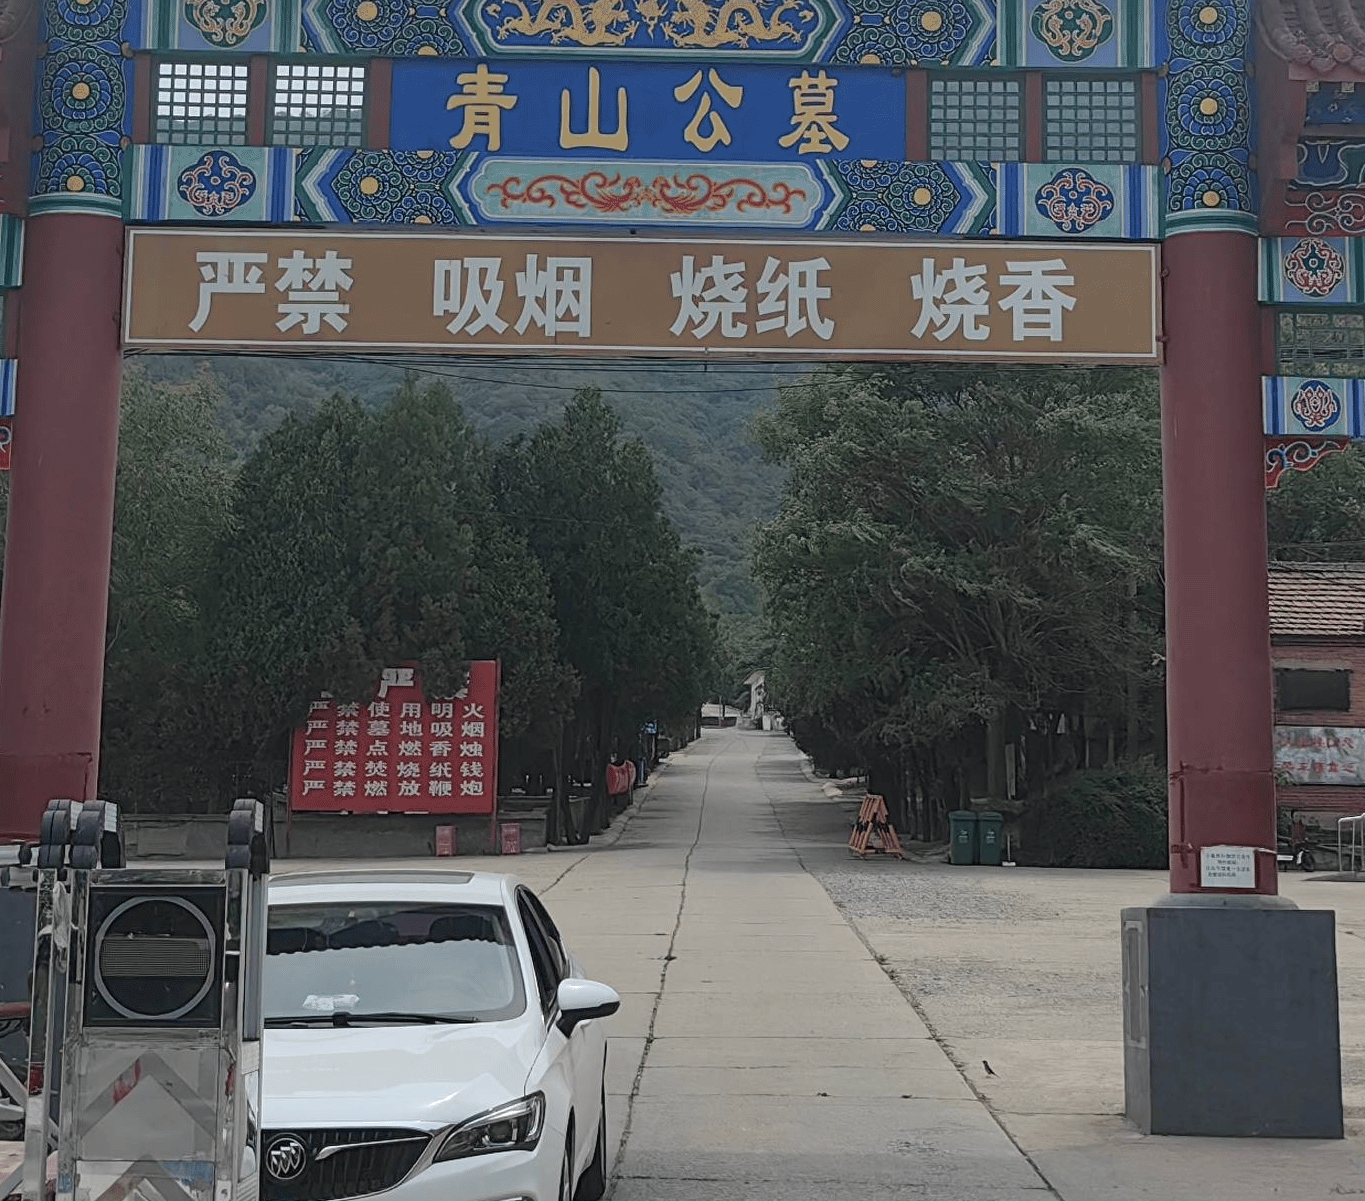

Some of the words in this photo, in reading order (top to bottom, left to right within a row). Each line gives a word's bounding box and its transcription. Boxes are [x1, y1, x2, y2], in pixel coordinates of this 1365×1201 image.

[446, 64, 850, 153] 青山公墓
[189, 249, 354, 338] 严禁
[433, 254, 593, 340] 吸烟
[670, 255, 836, 340] 烧纸
[910, 258, 1077, 341] 烧香
[307, 701, 485, 719] 严禁使用明火
[306, 720, 485, 738] 严禁墓地吸烟
[304, 739, 484, 758] 严禁点燃香烛
[303, 760, 484, 778] 严禁焚烧纸钱
[302, 780, 484, 797] 严禁燃放鞭炮
